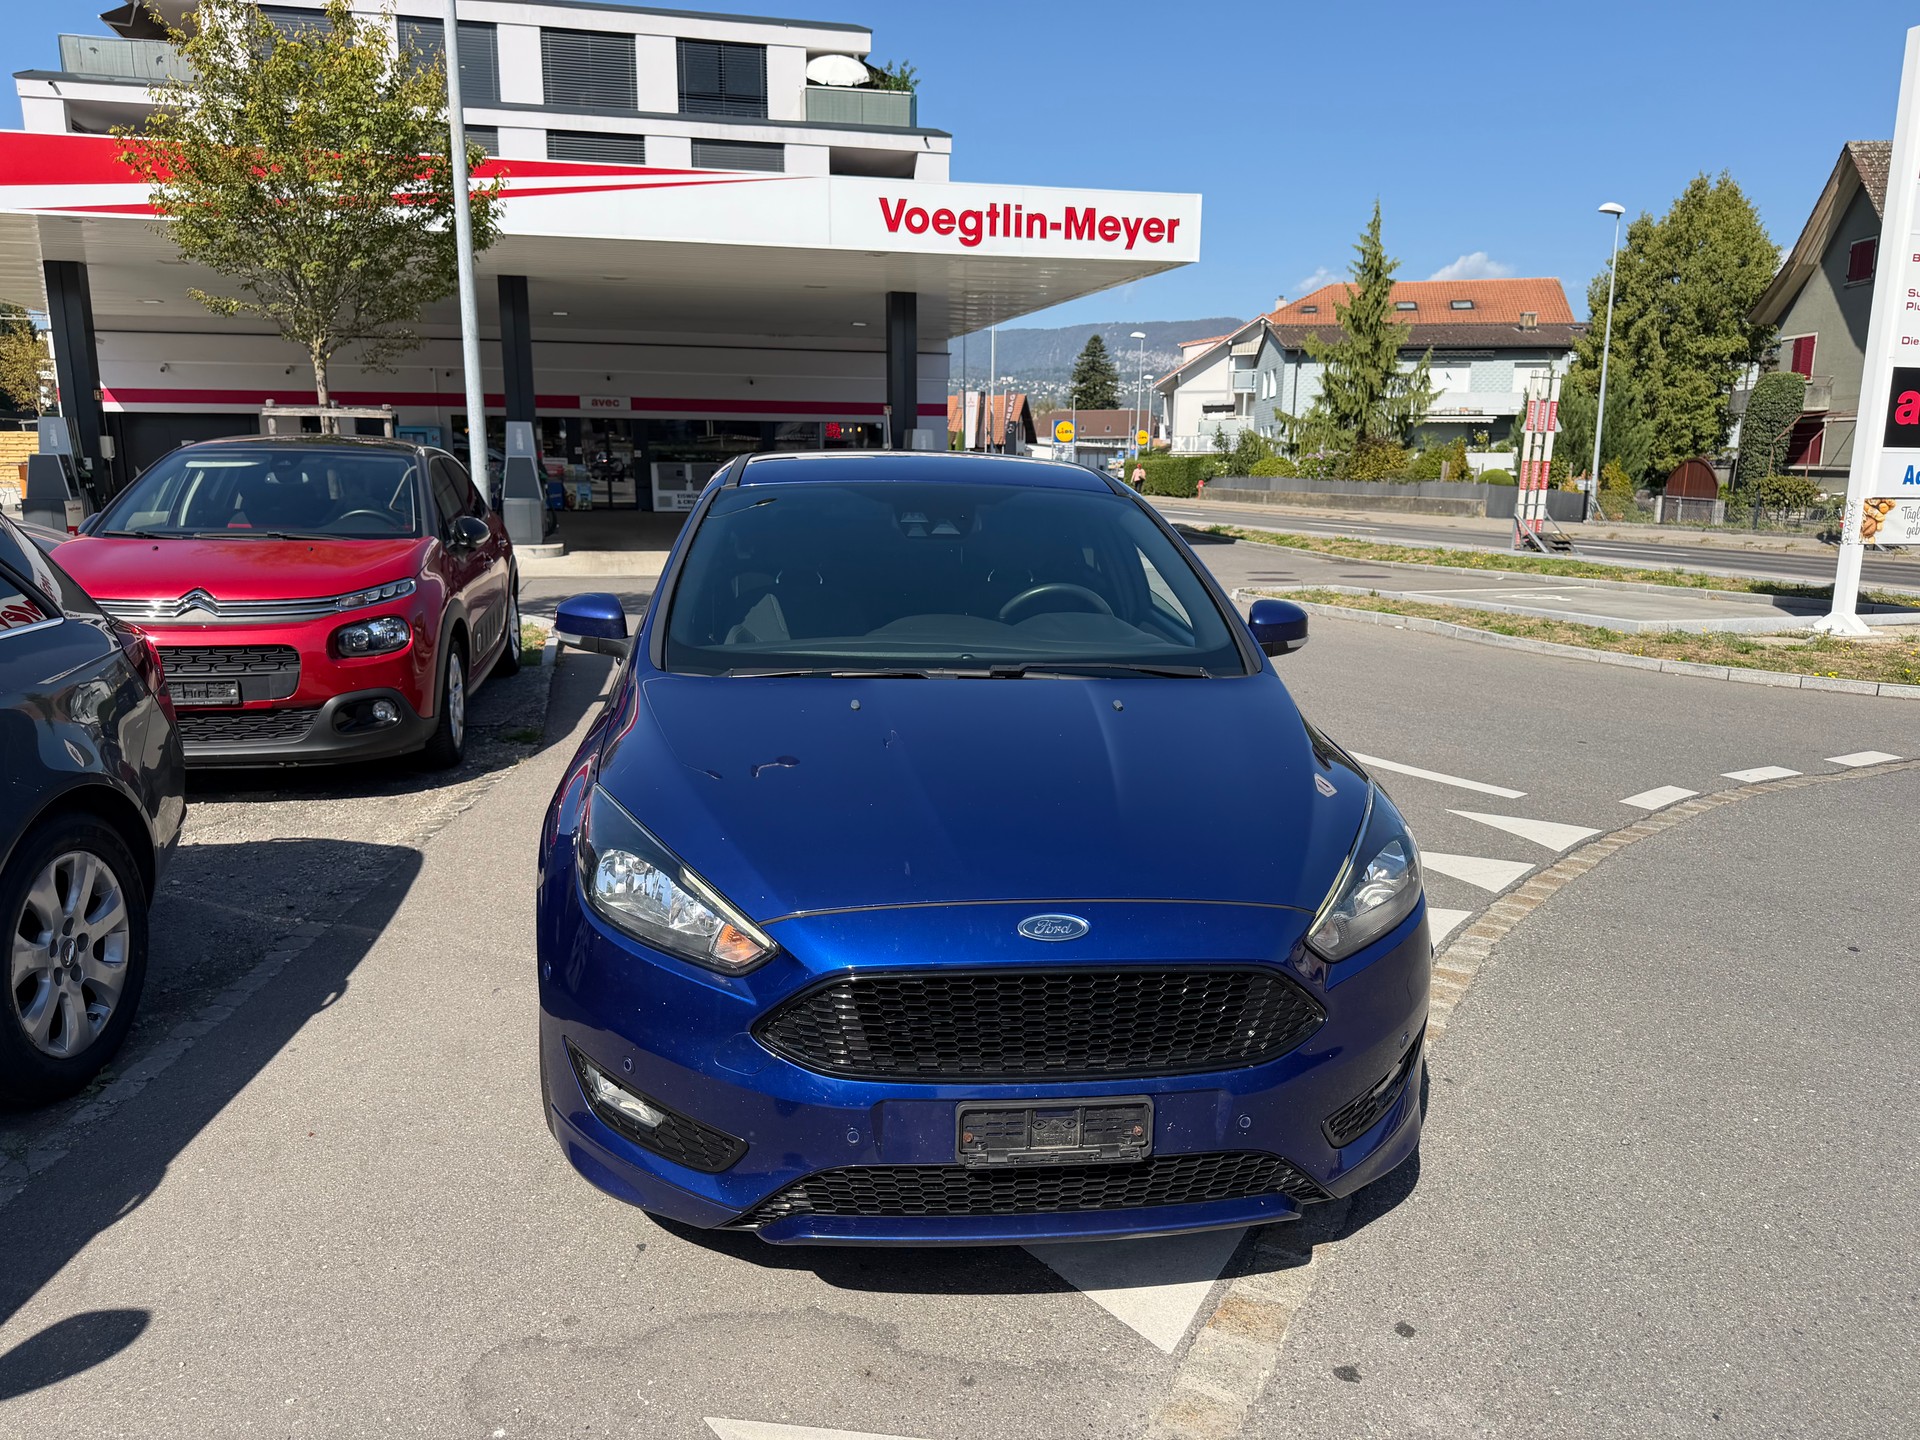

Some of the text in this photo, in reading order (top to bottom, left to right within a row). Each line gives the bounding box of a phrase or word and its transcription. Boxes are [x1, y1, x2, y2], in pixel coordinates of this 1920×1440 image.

[878, 197, 1180, 250] Voegtlin-Meyer
[591, 398, 620, 408] avec
[1034, 919, 1073, 934] Ford
